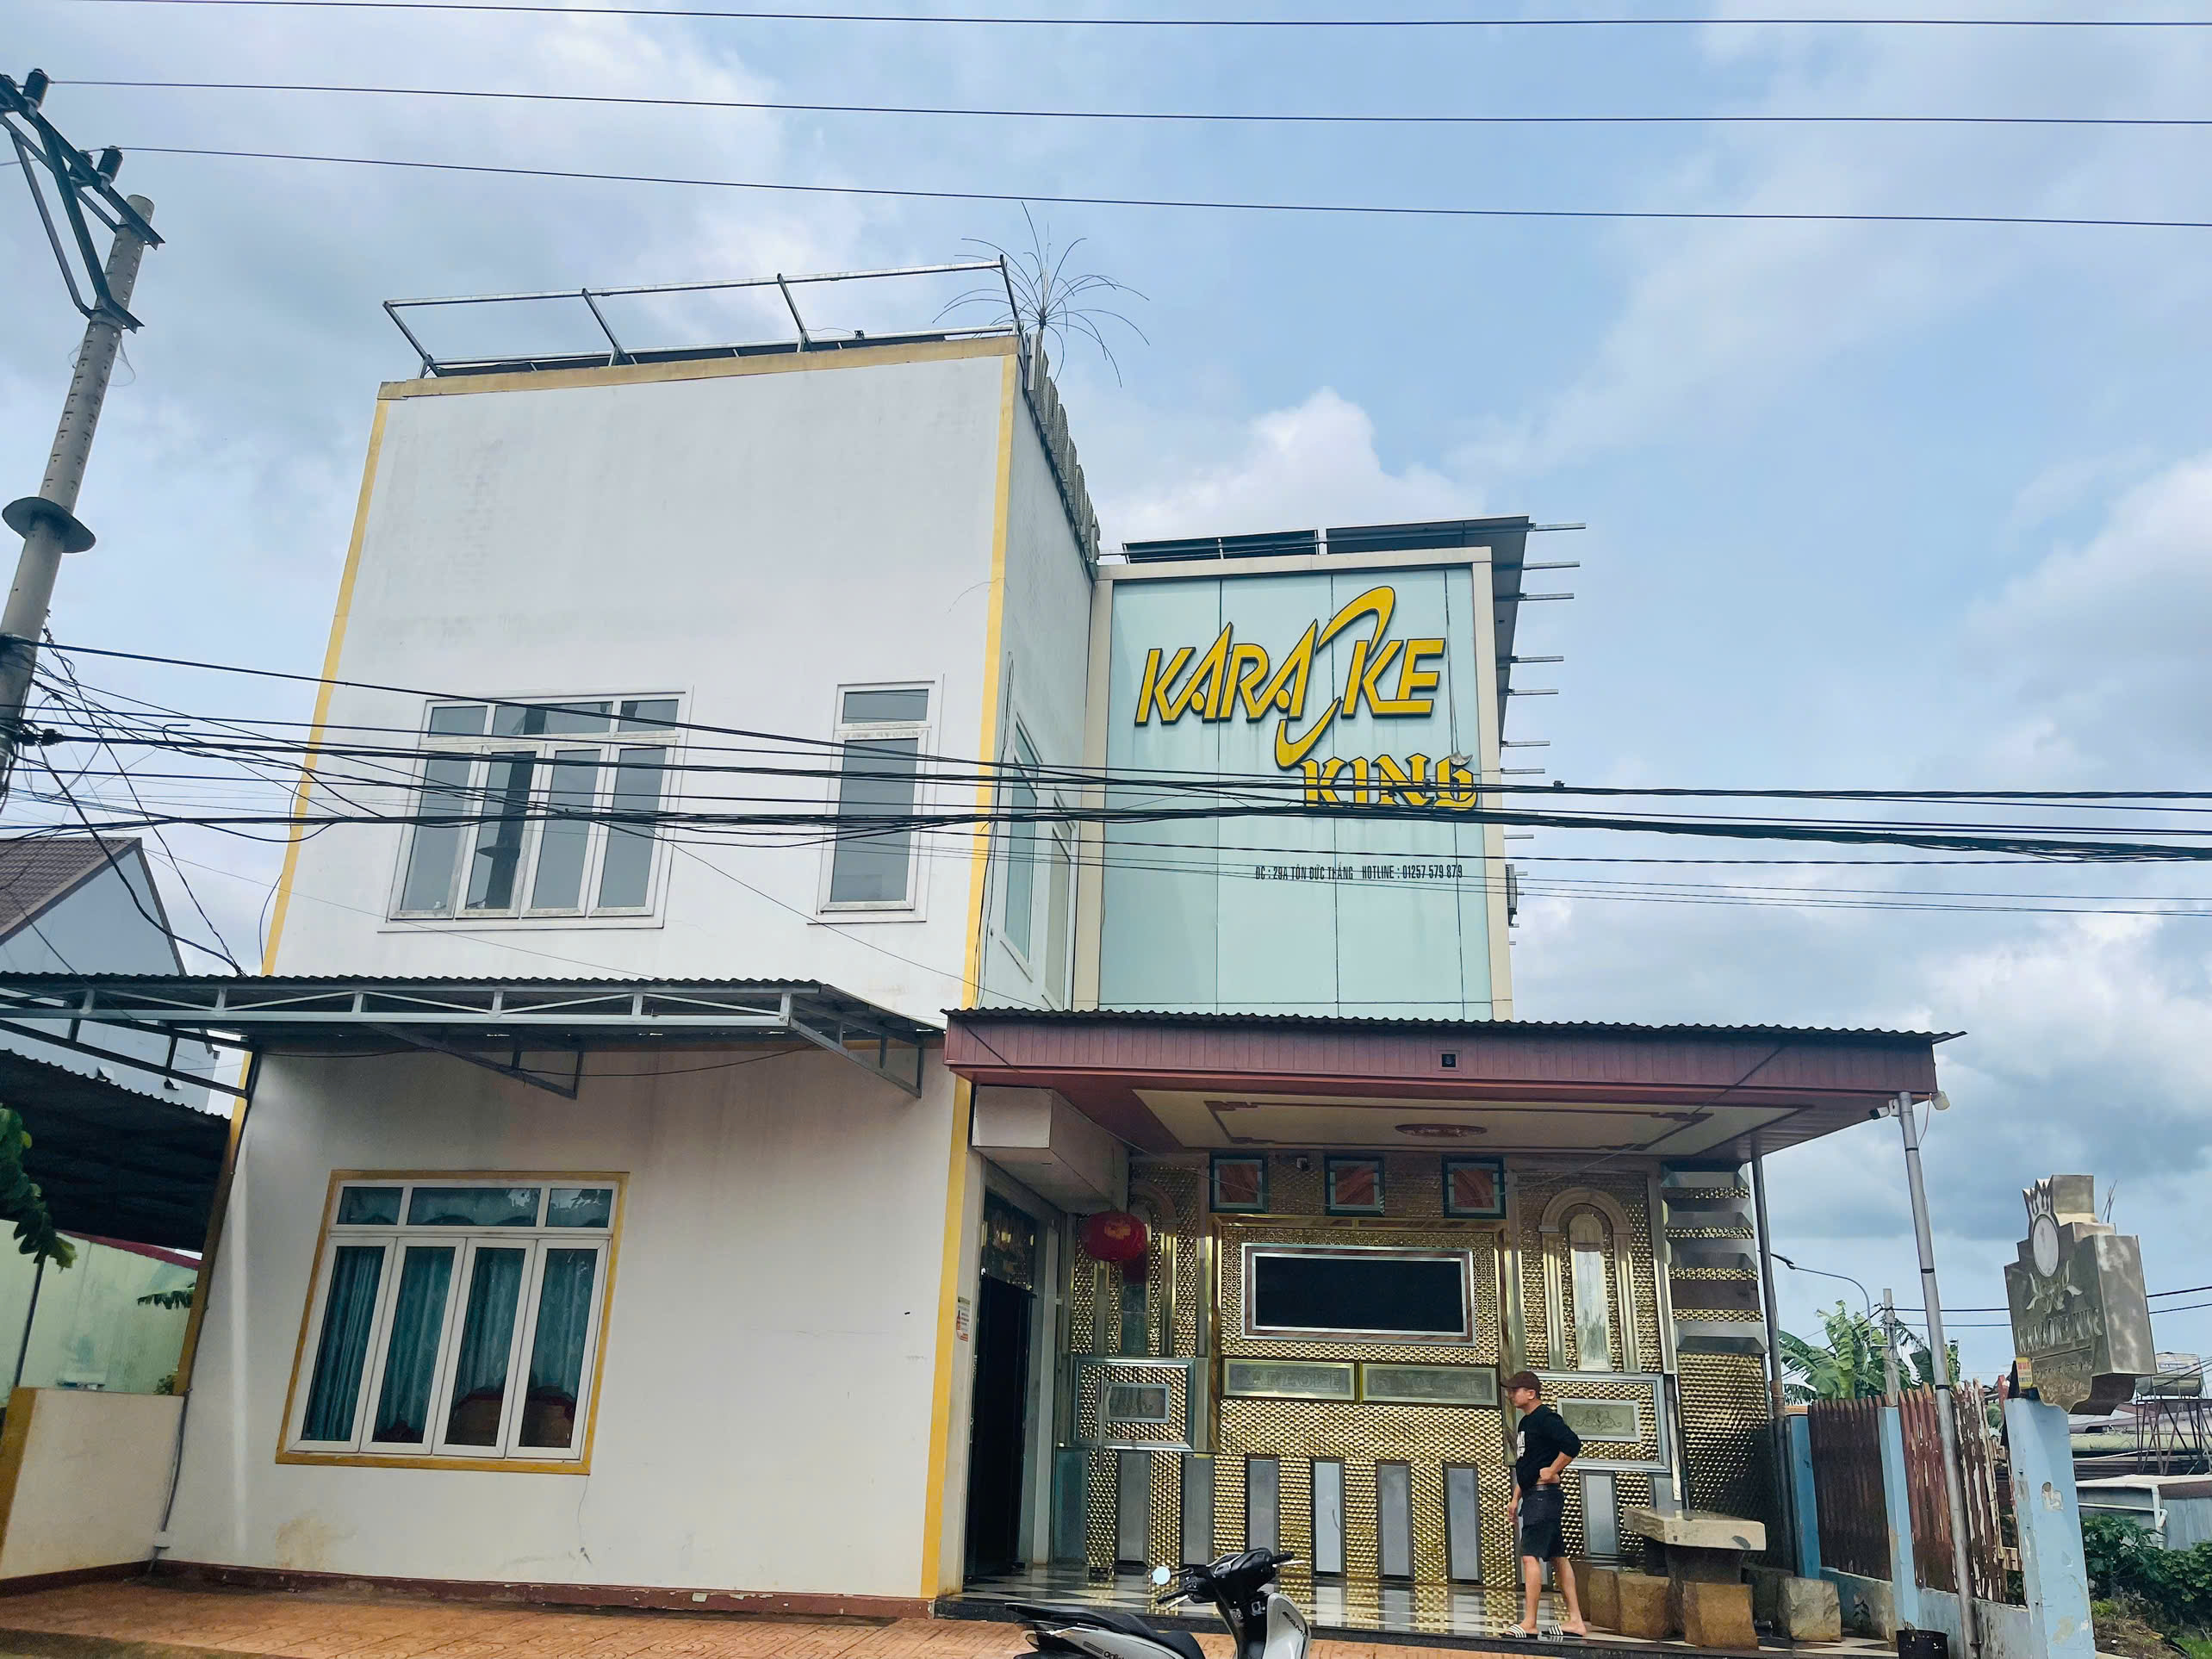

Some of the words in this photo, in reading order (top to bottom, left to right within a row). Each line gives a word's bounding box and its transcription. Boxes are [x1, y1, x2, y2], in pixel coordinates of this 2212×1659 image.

[1134, 585, 1447, 770] KARAOKE
[1296, 752, 1478, 812] KING
[1291, 864, 1307, 880] TÔN
[1309, 864, 1325, 880] ĐỨC
[1362, 865, 1395, 879] HOTLINE
[1402, 865, 1426, 879] 01257
[1429, 864, 1444, 879] 579
[1446, 864, 1463, 879] 879
